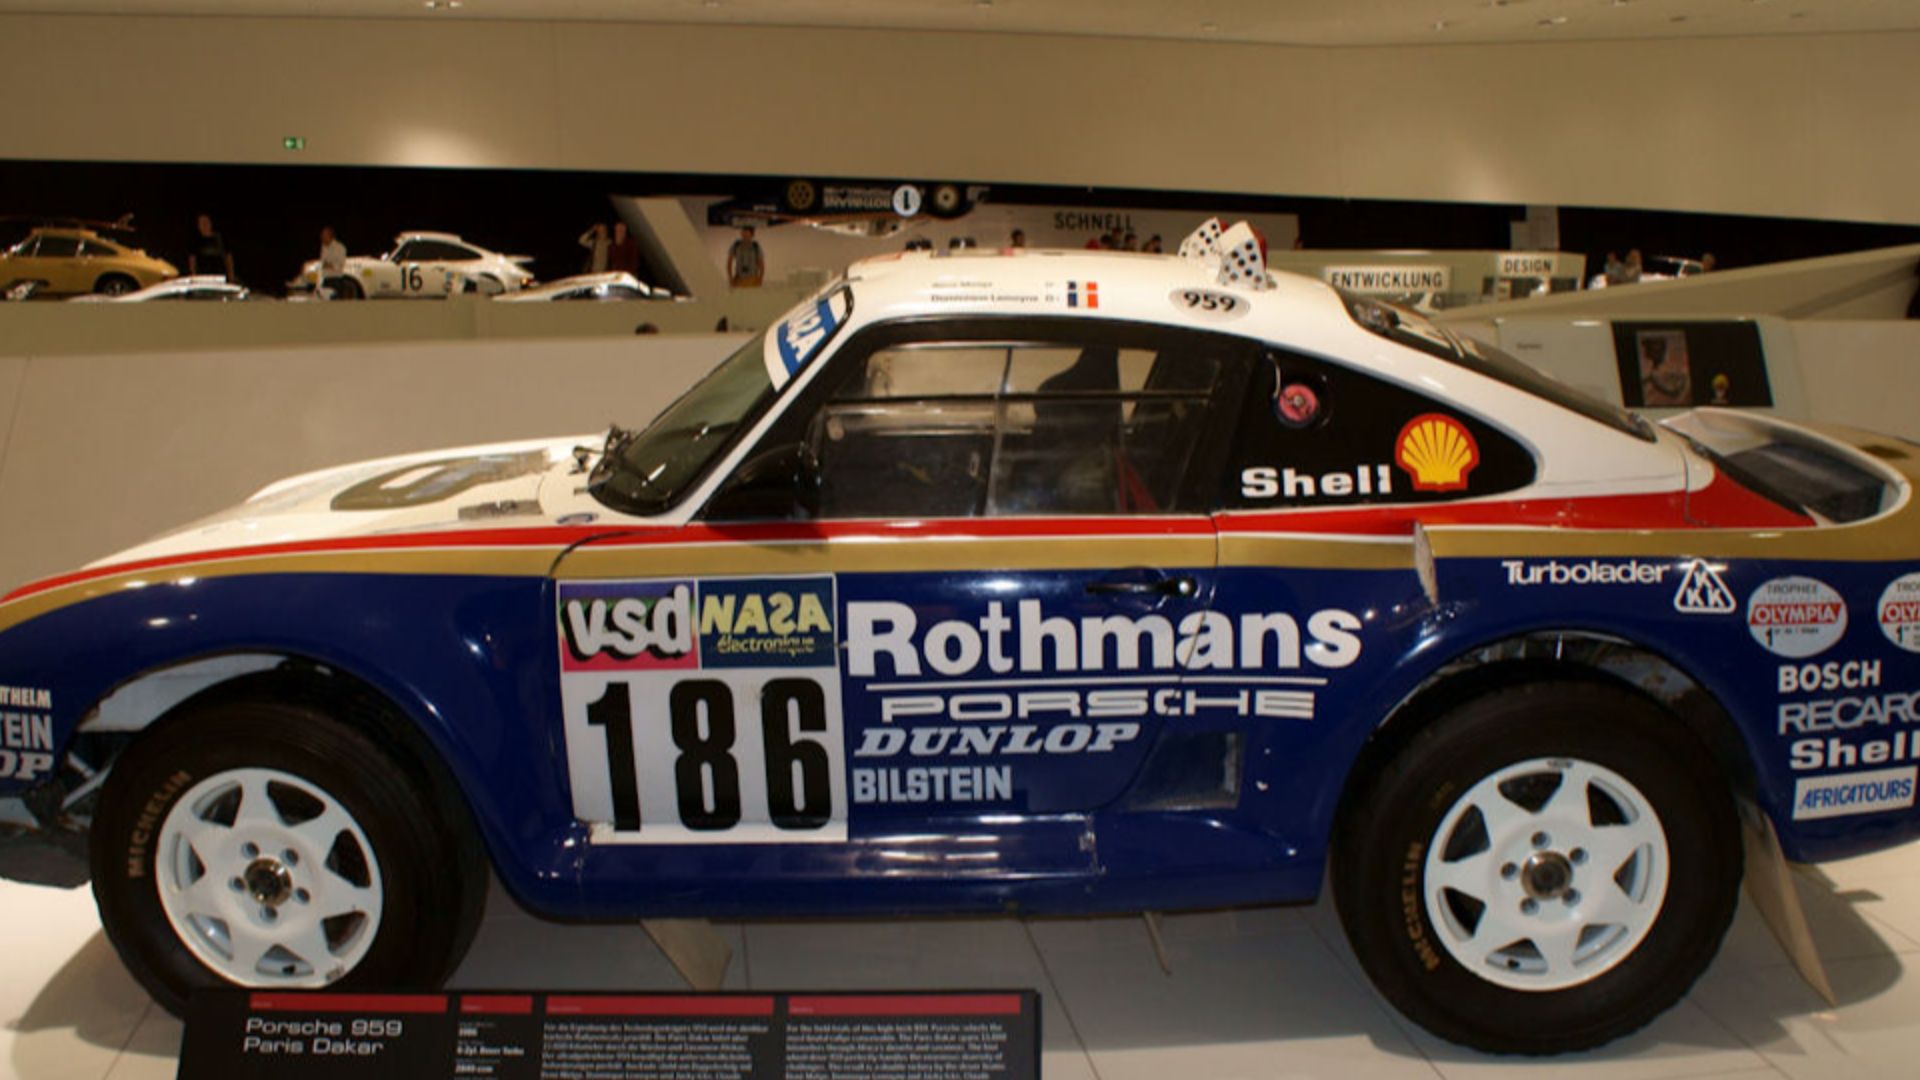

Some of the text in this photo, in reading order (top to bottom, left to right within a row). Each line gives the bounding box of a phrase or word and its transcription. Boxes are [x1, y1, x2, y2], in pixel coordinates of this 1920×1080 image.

[1053, 211, 1135, 231] SCHNELL
[400, 265, 423, 291] 16
[1331, 271, 1443, 288] ENTWICKLUNG
[1503, 259, 1552, 273] DESIGN
[1184, 291, 1237, 313] 959
[1240, 463, 1393, 498] Shell
[1501, 560, 1671, 585] Turbolader
[566, 583, 693, 661] vsd
[1754, 605, 1837, 624] OLYMPIA
[846, 598, 1364, 677] Rothmans
[1778, 659, 1882, 693] BOSCH
[881, 690, 1316, 722] PORSCHE
[586, 676, 833, 833] 186
[853, 723, 1140, 758] DUNLOP
[1789, 731, 1920, 770] Shell
[852, 766, 1013, 803] BILSTEIN
[1800, 778, 1913, 811] AFRICATOURS
[128, 769, 193, 878] MICHELIN
[246, 1017, 403, 1037] Porsche 959
[243, 1036, 385, 1055] Paris Dakar
